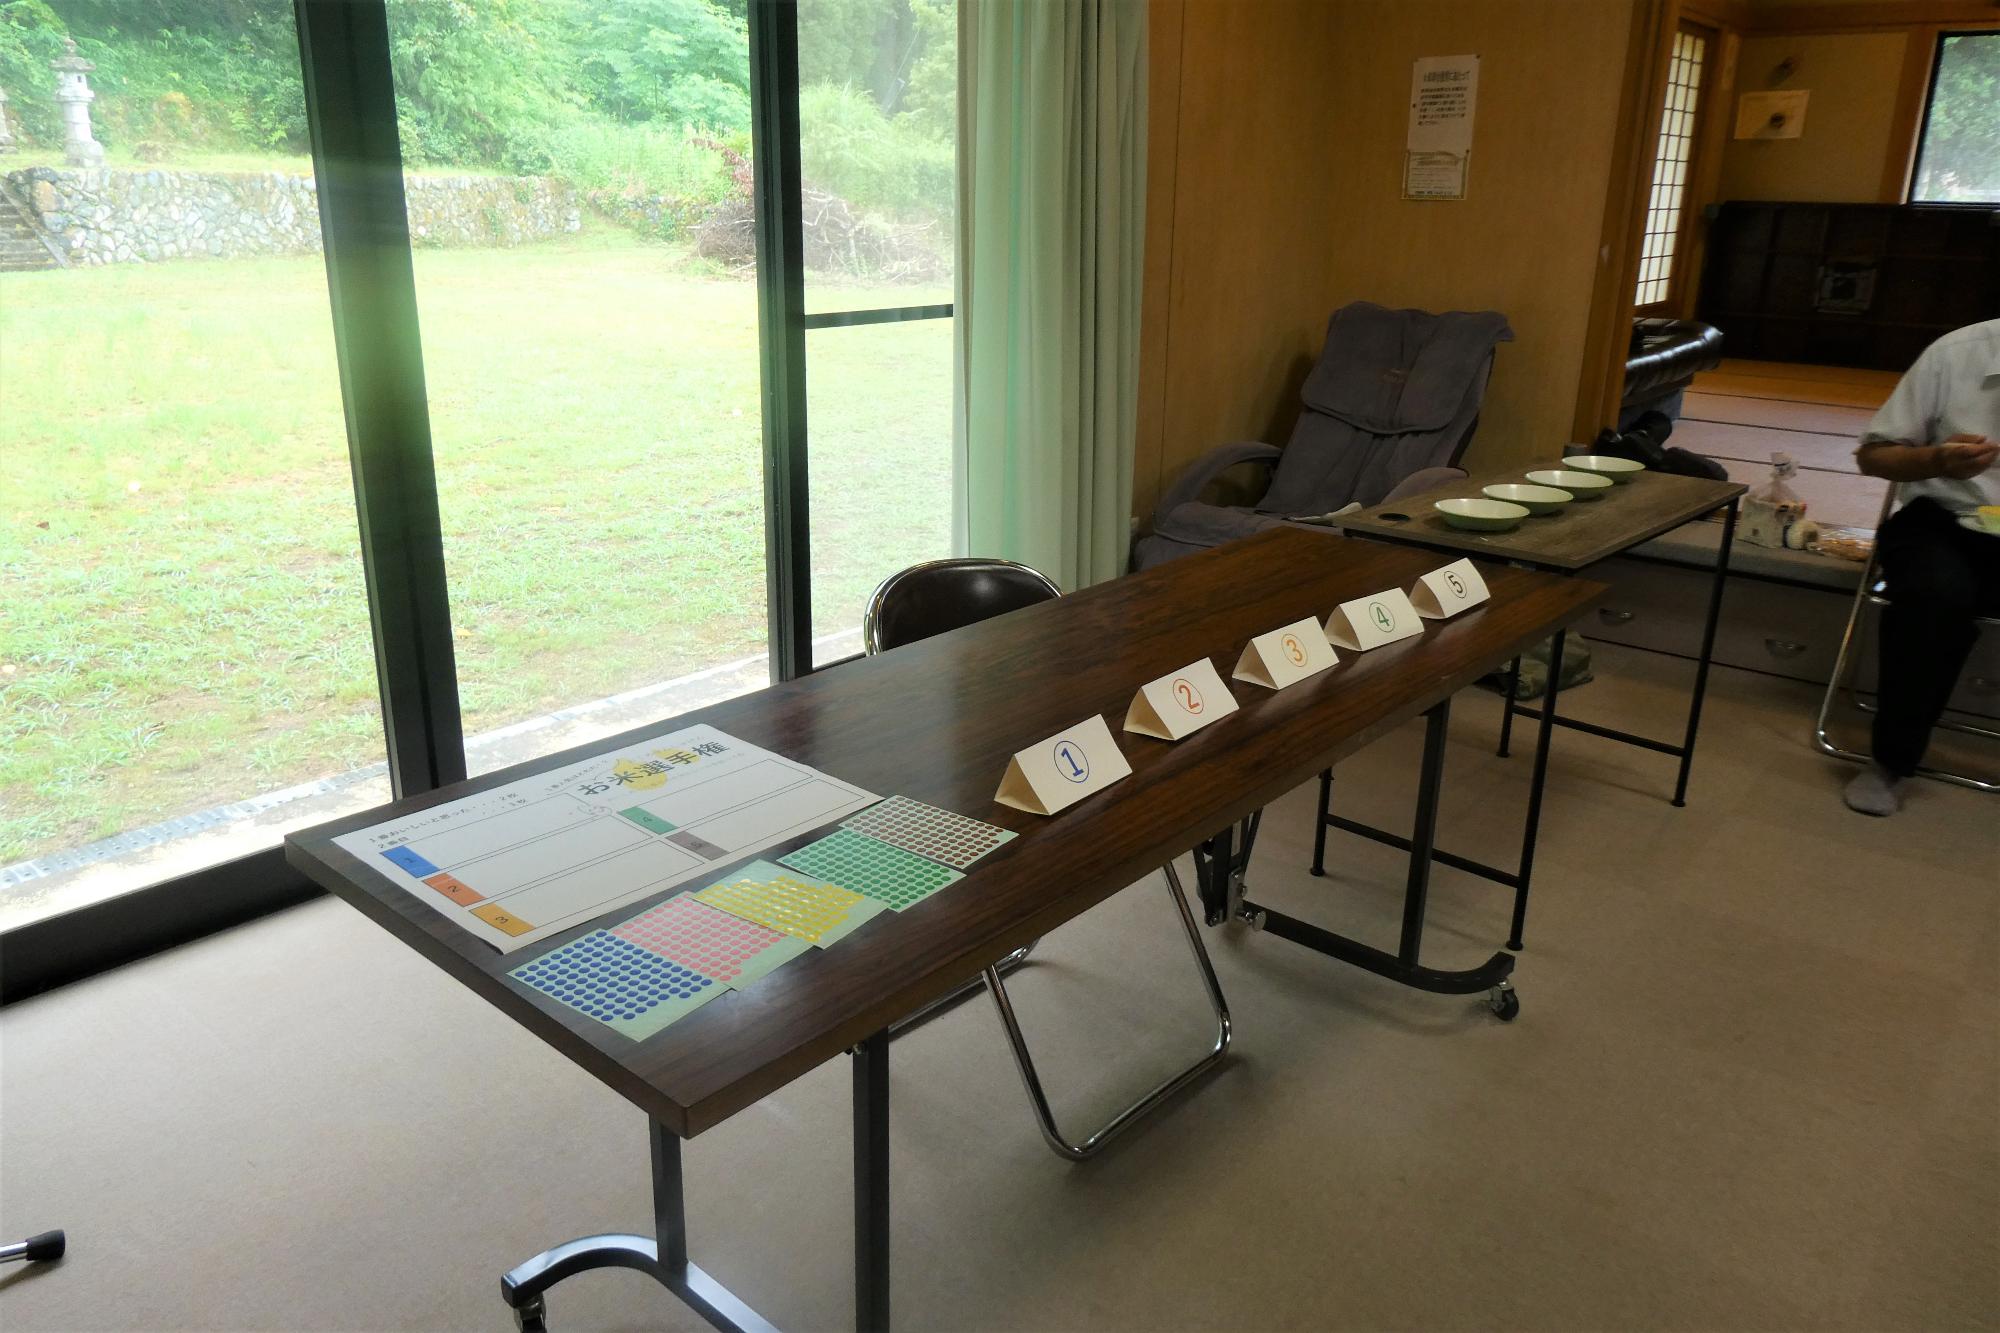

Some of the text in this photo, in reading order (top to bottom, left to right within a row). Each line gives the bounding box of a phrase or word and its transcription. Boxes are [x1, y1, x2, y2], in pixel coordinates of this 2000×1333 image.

[578, 741, 731, 795] お米選手権
[447, 885, 460, 893] 2
[495, 916, 509, 924] 3
